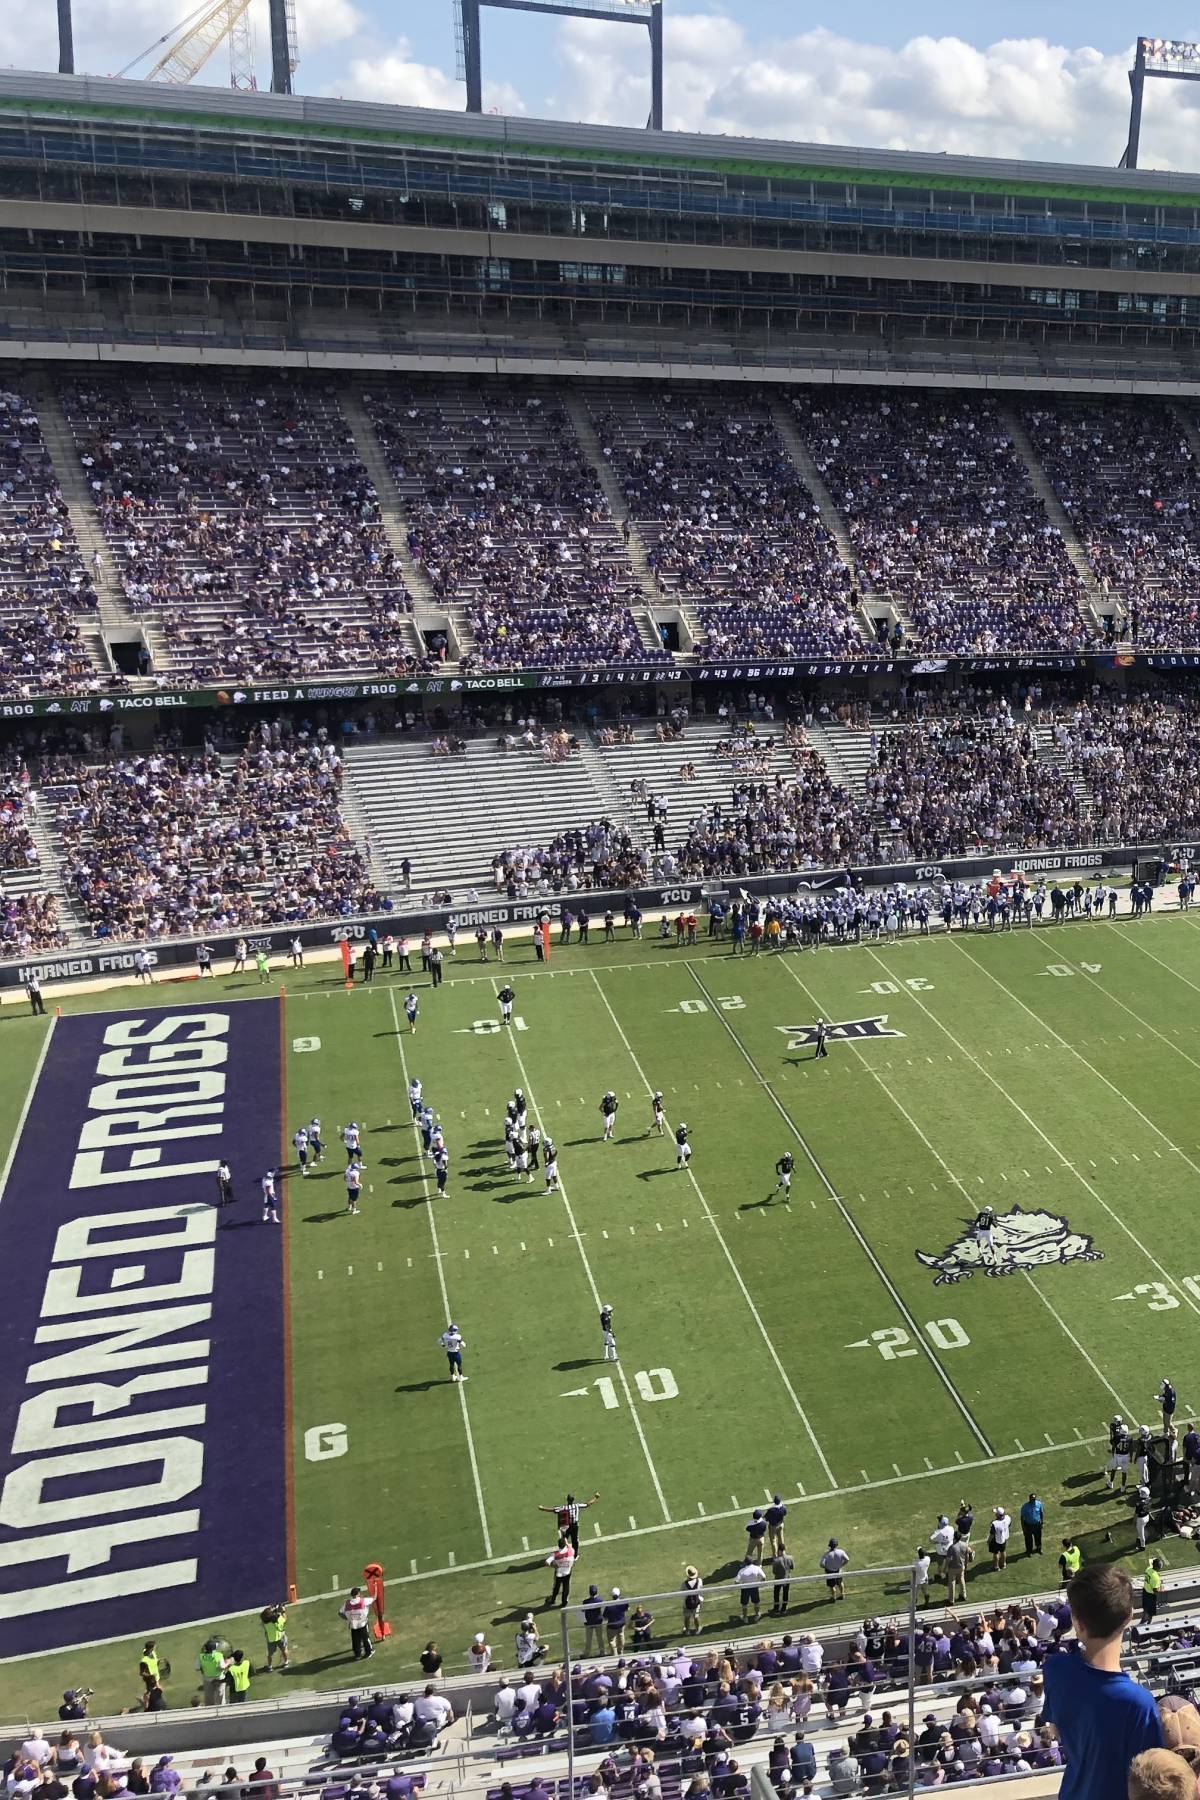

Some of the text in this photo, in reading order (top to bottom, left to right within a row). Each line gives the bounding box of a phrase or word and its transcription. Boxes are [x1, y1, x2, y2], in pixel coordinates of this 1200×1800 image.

[591, 673, 599, 682] 3
[667, 671, 681, 679] 43
[715, 670, 727, 678] 43
[254, 681, 445, 701] FEED A HUNGRY FROG AT
[465, 677, 524, 689] TACO BELL
[0, 700, 91, 715] ROG AT
[118, 696, 187, 708] TACO BELL
[1170, 847, 1196, 860] TCU
[1014, 854, 1103, 872] HORNED FROGS
[915, 865, 944, 881] TCU
[660, 889, 692, 905] TCU
[451, 908, 509, 928] HORNED
[331, 926, 365, 942] TCU
[18, 951, 158, 983] HORNED FROS
[1045, 961, 1103, 977] 40
[868, 977, 936, 996] 30
[678, 995, 748, 1014] 20
[0, 1012, 231, 1619] HORNED FROGS
[870, 1318, 971, 1361] 20
[593, 1367, 680, 1410] 10
[304, 1422, 349, 1462] G
[873, 1638, 881, 1650] 5
[624, 1710, 635, 1721] 14
[739, 1711, 749, 1724] 5
